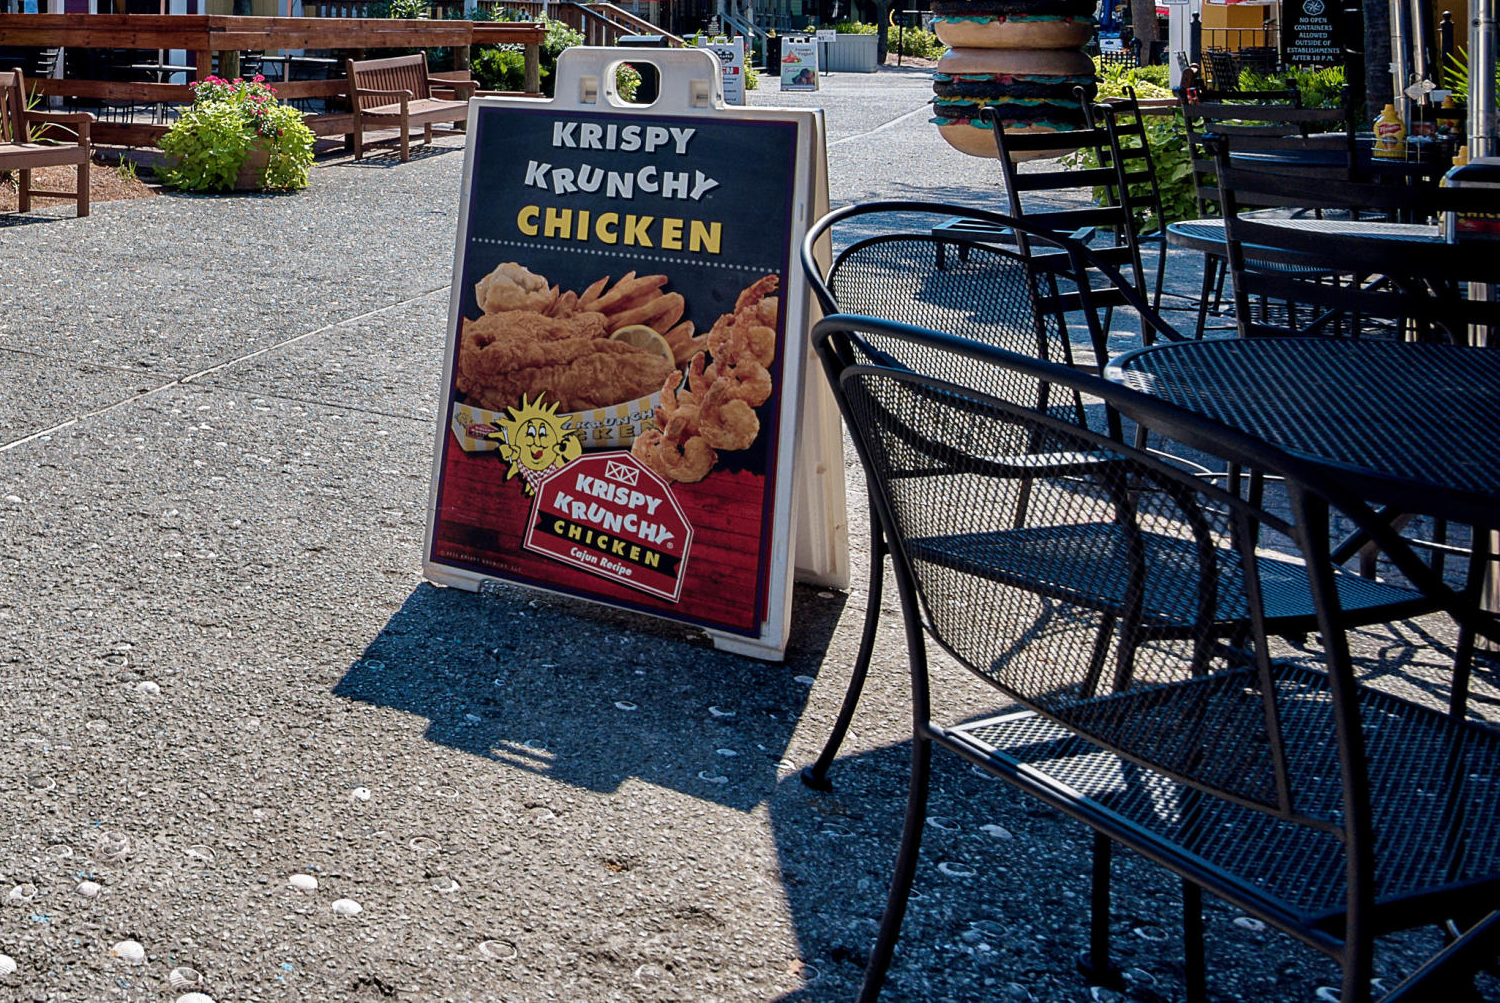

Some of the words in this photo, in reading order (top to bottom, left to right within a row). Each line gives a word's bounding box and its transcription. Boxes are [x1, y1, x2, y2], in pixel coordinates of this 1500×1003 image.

[553, 121, 695, 154] KRISPY
[524, 160, 719, 201] KRUNCHY
[516, 205, 722, 254] CHICKEN
[576, 405, 660, 430] KRUNCH
[575, 473, 662, 515] KRISPY
[554, 491, 675, 545] KRUNCHY
[554, 520, 660, 568] CHICKEN
[570, 547, 598, 564] Cajun
[600, 557, 632, 576] Recipe
